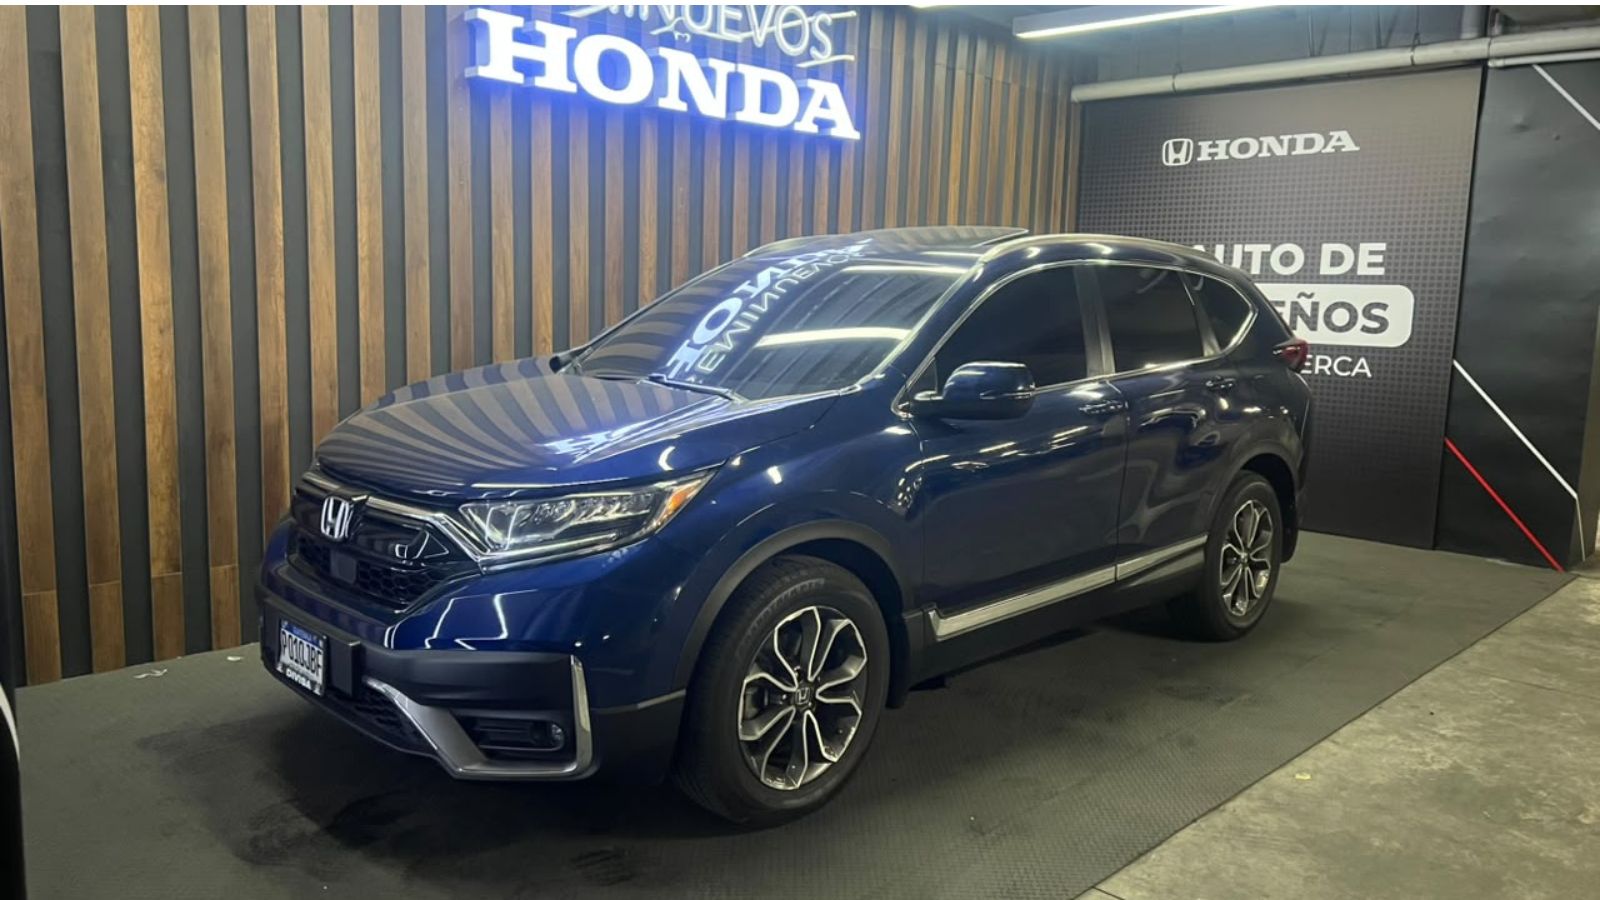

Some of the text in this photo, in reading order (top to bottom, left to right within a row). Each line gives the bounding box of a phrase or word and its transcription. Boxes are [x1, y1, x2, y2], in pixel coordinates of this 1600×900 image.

[466, 8, 860, 139] HONDA
[1197, 130, 1360, 161] HONDA
[1193, 242, 1387, 275] UTO DE
[1270, 292, 1389, 334] ÑOS
[1300, 355, 1372, 377] ERCA
